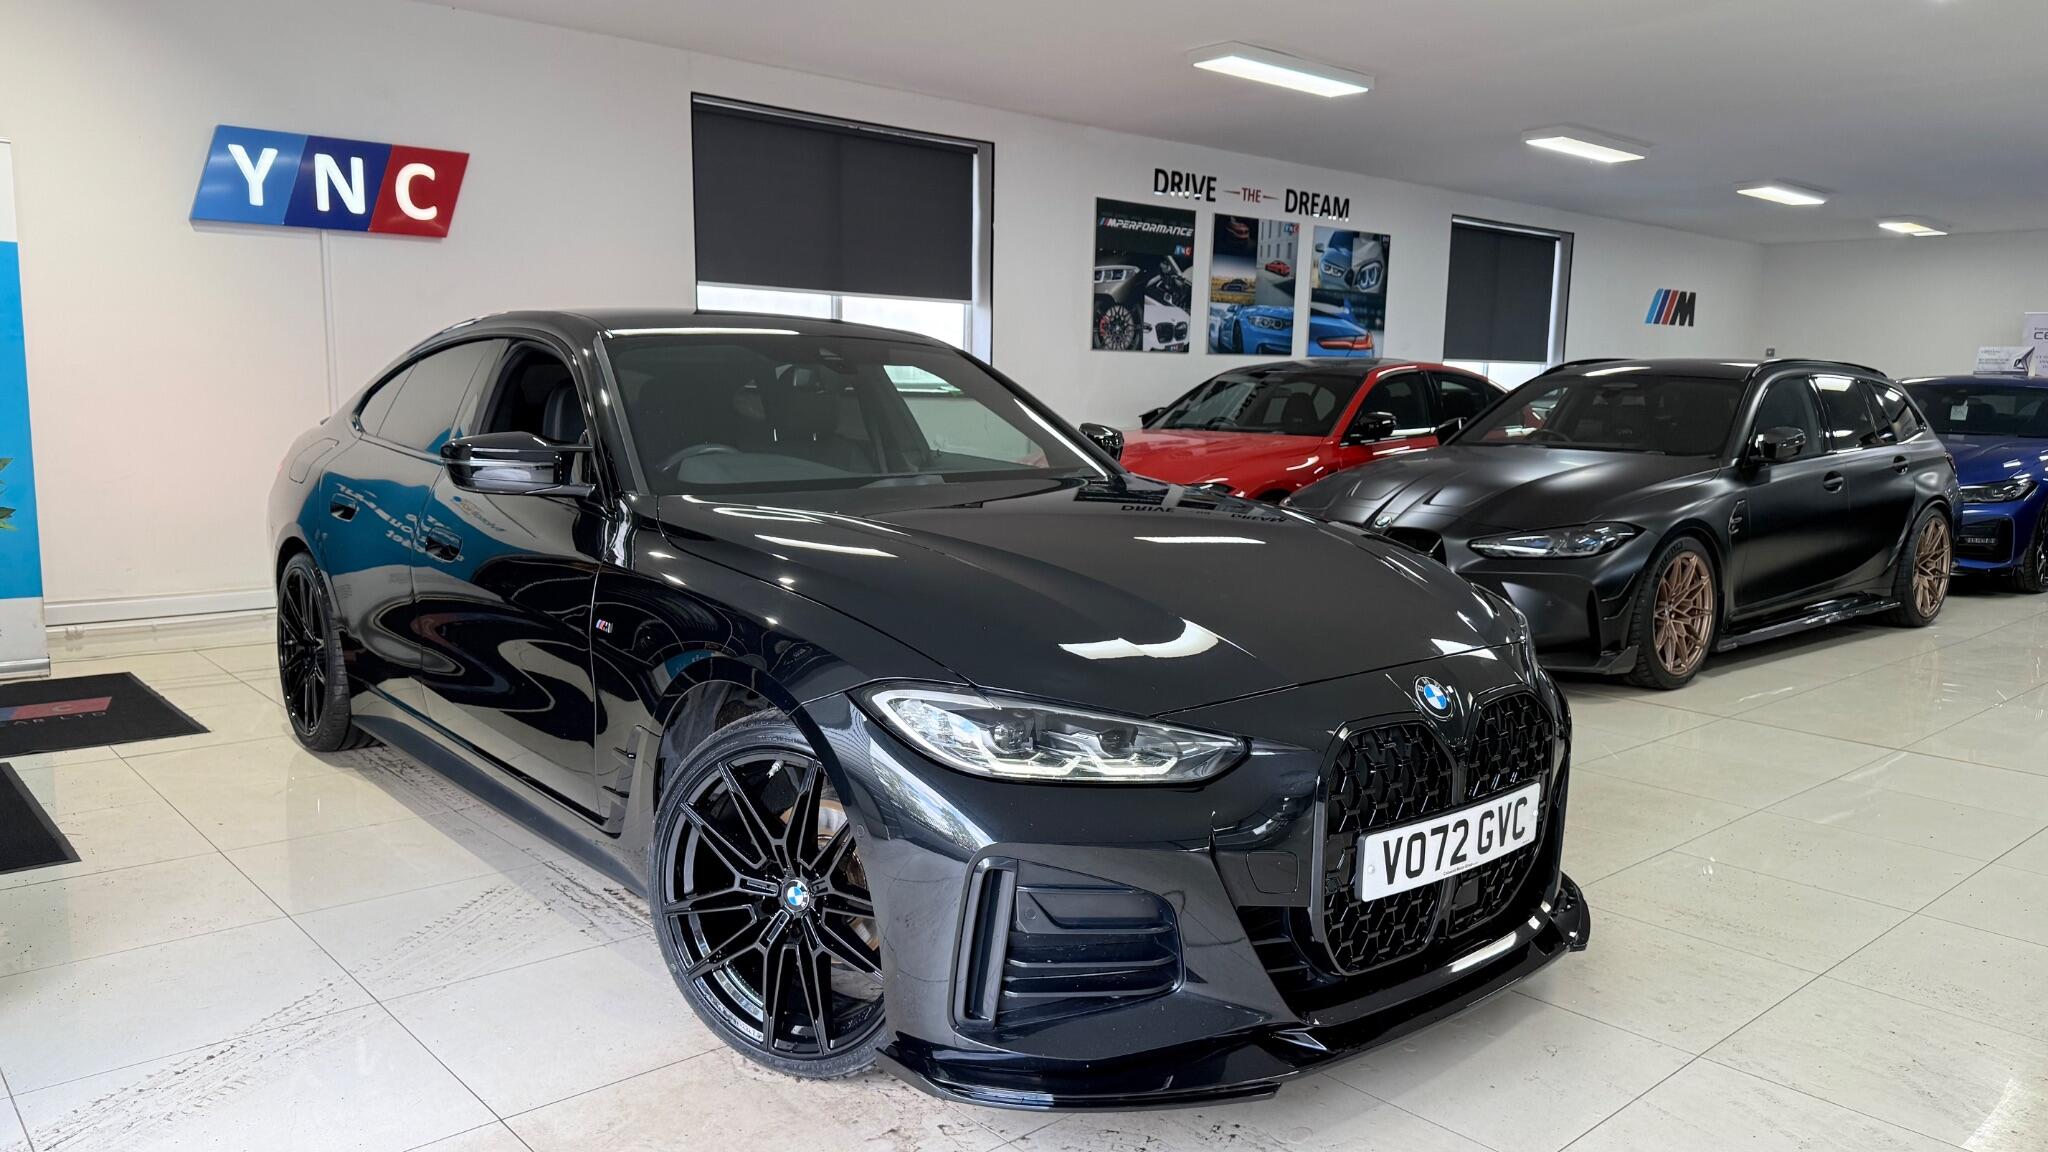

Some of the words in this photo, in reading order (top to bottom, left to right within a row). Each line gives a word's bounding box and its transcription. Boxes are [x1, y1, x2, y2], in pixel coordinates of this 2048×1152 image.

[227, 143, 438, 221] YNC
[1154, 168, 1217, 202] DRIVE
[1242, 187, 1262, 203] THE
[1285, 188, 1350, 221] DREAM
[1383, 818, 1469, 886] VO72
[1477, 796, 1528, 855] GVC
